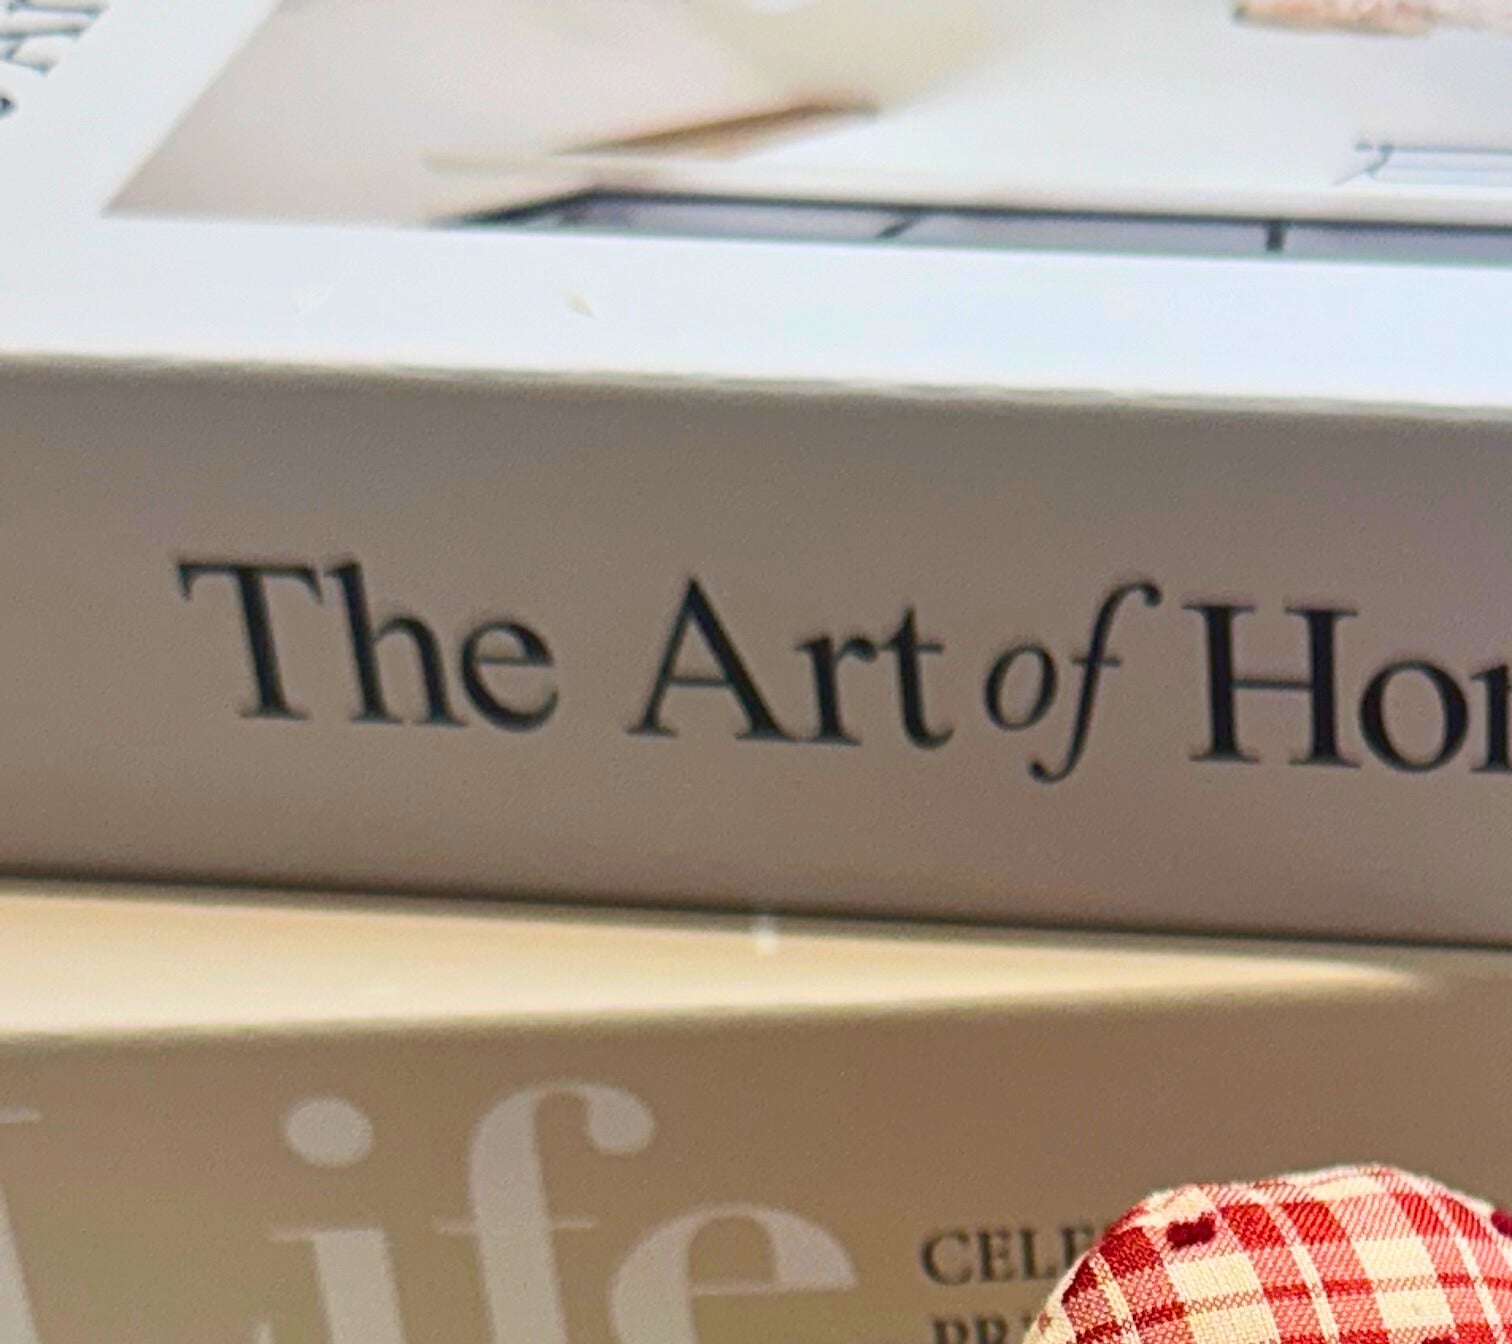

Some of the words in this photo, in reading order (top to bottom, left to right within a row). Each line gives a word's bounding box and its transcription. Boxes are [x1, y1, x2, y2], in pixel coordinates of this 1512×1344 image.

[177, 558, 560, 734] The
[626, 573, 957, 751] Art
[984, 580, 1164, 785] of
